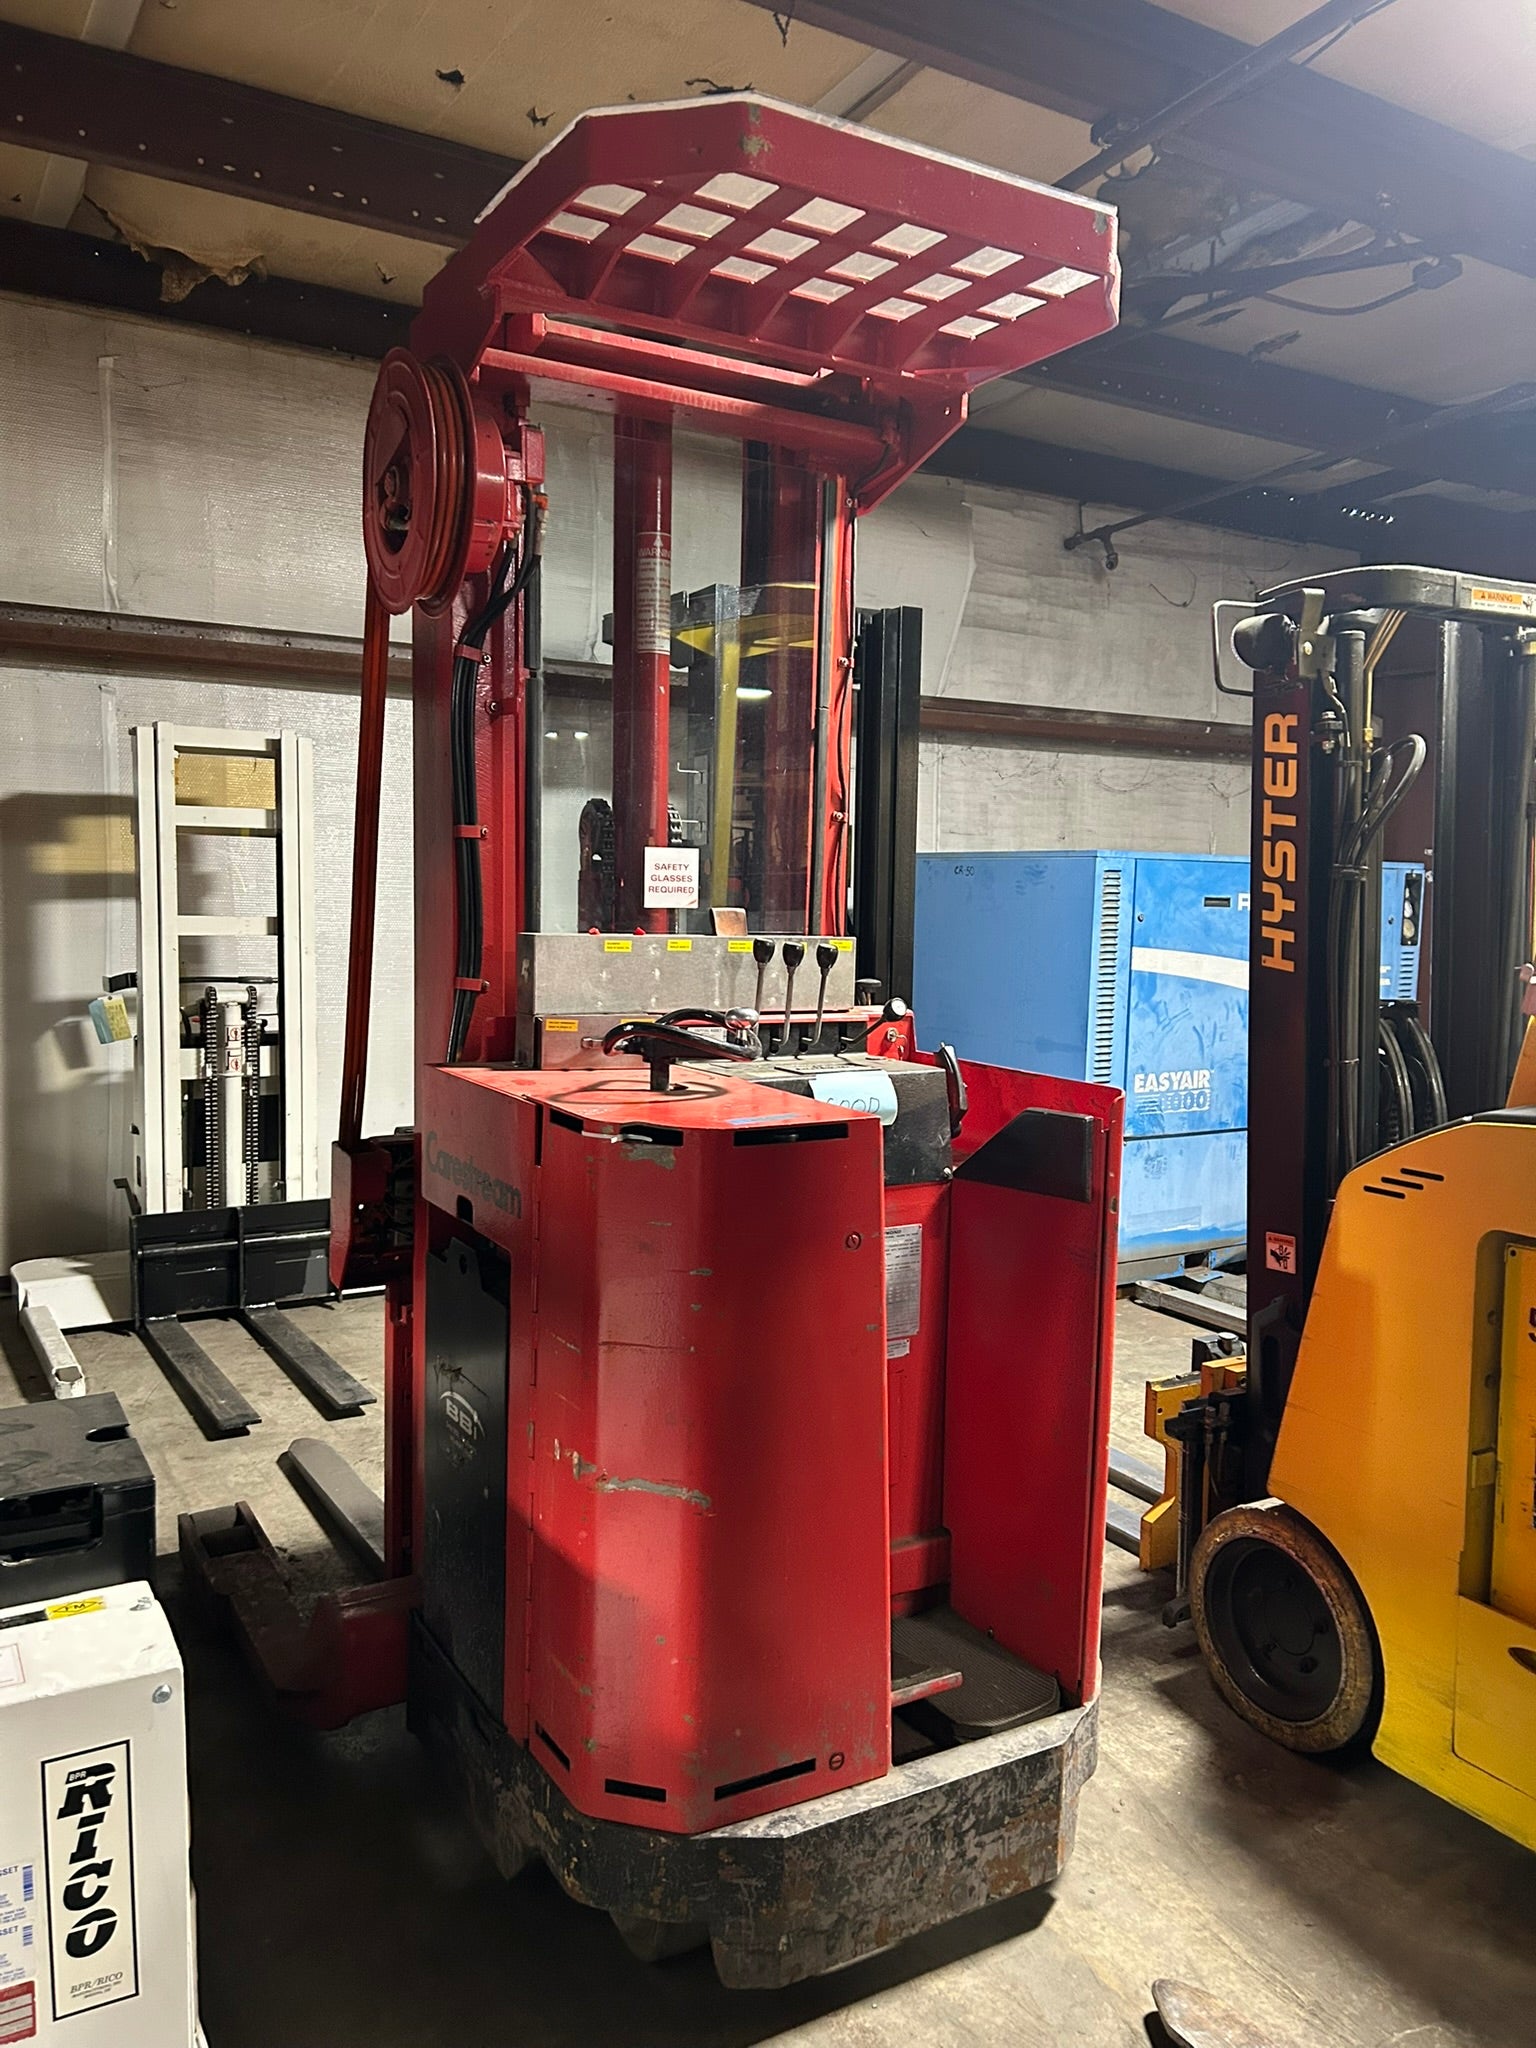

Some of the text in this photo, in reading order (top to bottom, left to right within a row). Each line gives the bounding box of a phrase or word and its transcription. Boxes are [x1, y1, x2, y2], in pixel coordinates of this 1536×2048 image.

[1261, 712, 1298, 973] HYSTER
[650, 874, 693, 882] GLASSES
[654, 863, 689, 871] SAFETY
[648, 885, 695, 894] REQUIRED
[1134, 1069, 1211, 1093] EASYAIR
[57, 1763, 118, 1958] RICO
[70, 1971, 123, 1994] BPR/RICO
